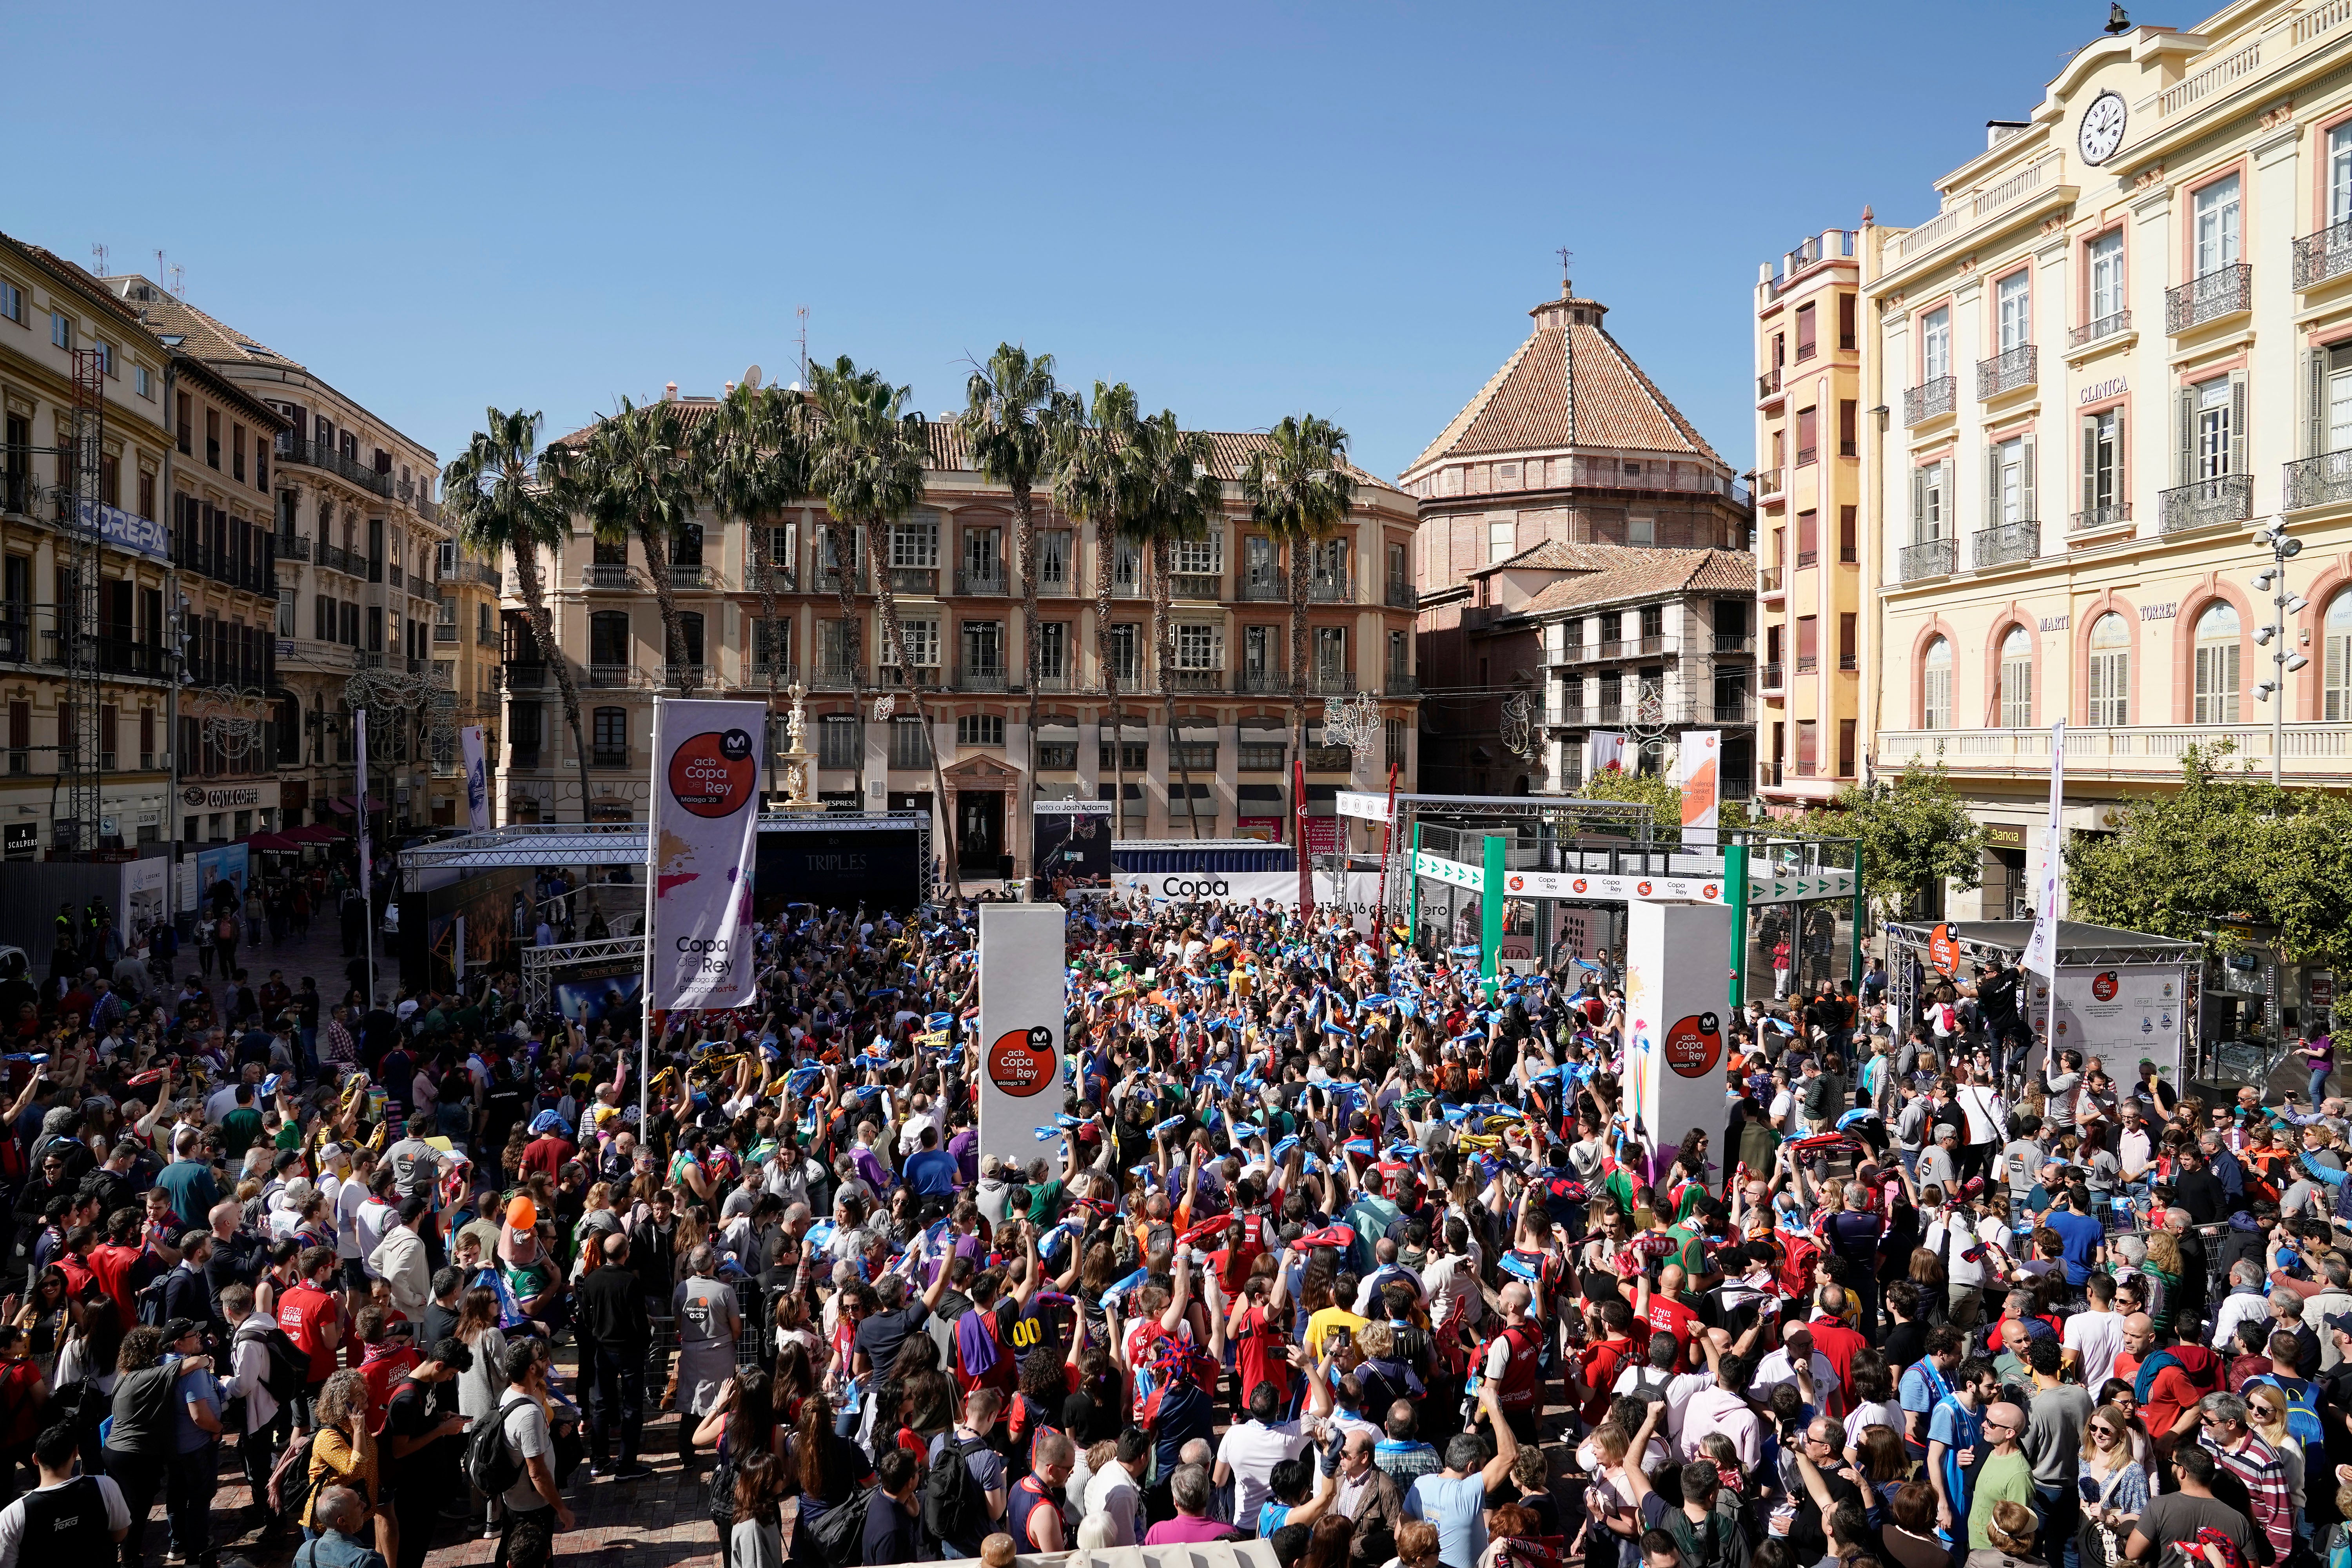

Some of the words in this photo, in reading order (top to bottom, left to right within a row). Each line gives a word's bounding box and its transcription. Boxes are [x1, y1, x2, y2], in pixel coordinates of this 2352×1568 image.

[2081, 376, 2127, 403] CLINICA
[2040, 615, 2069, 632] MARTI
[2140, 603, 2176, 621] TORRES
[694, 757, 716, 766] acb
[685, 766, 726, 780] Copa
[706, 782, 733, 795] Rey
[210, 790, 234, 807] COSTA
[236, 789, 260, 804] COFFEE
[1992, 829, 2018, 842] Bankia
[8, 839, 38, 849] SCALPERS
[806, 854, 866, 871] TRIPLES
[1163, 877, 1229, 900] Copa
[1353, 902, 1366, 914] 16
[676, 936, 728, 955] Copa
[1934, 943, 1949, 953] Copa
[1942, 954, 1951, 964] Rey
[677, 956, 699, 967] del
[702, 957, 734, 976] Rey
[680, 984, 739, 993] Emocionarte
[1676, 1041, 1703, 1051] Copa
[1689, 1051, 1706, 1061] Rey
[1001, 1057, 1033, 1068] Copa
[1017, 1069, 1038, 1079] Rey
[283, 1306, 303, 1314] EGIZU
[1654, 1307, 1671, 1318] THIS
[282, 1313, 302, 1323] HANDI
[1650, 1319, 1672, 1330] AMBAR
[1013, 1317, 1042, 1347] 00
[389, 1361, 409, 1377] EGIZU
[388, 1367, 410, 1385] HANDI
